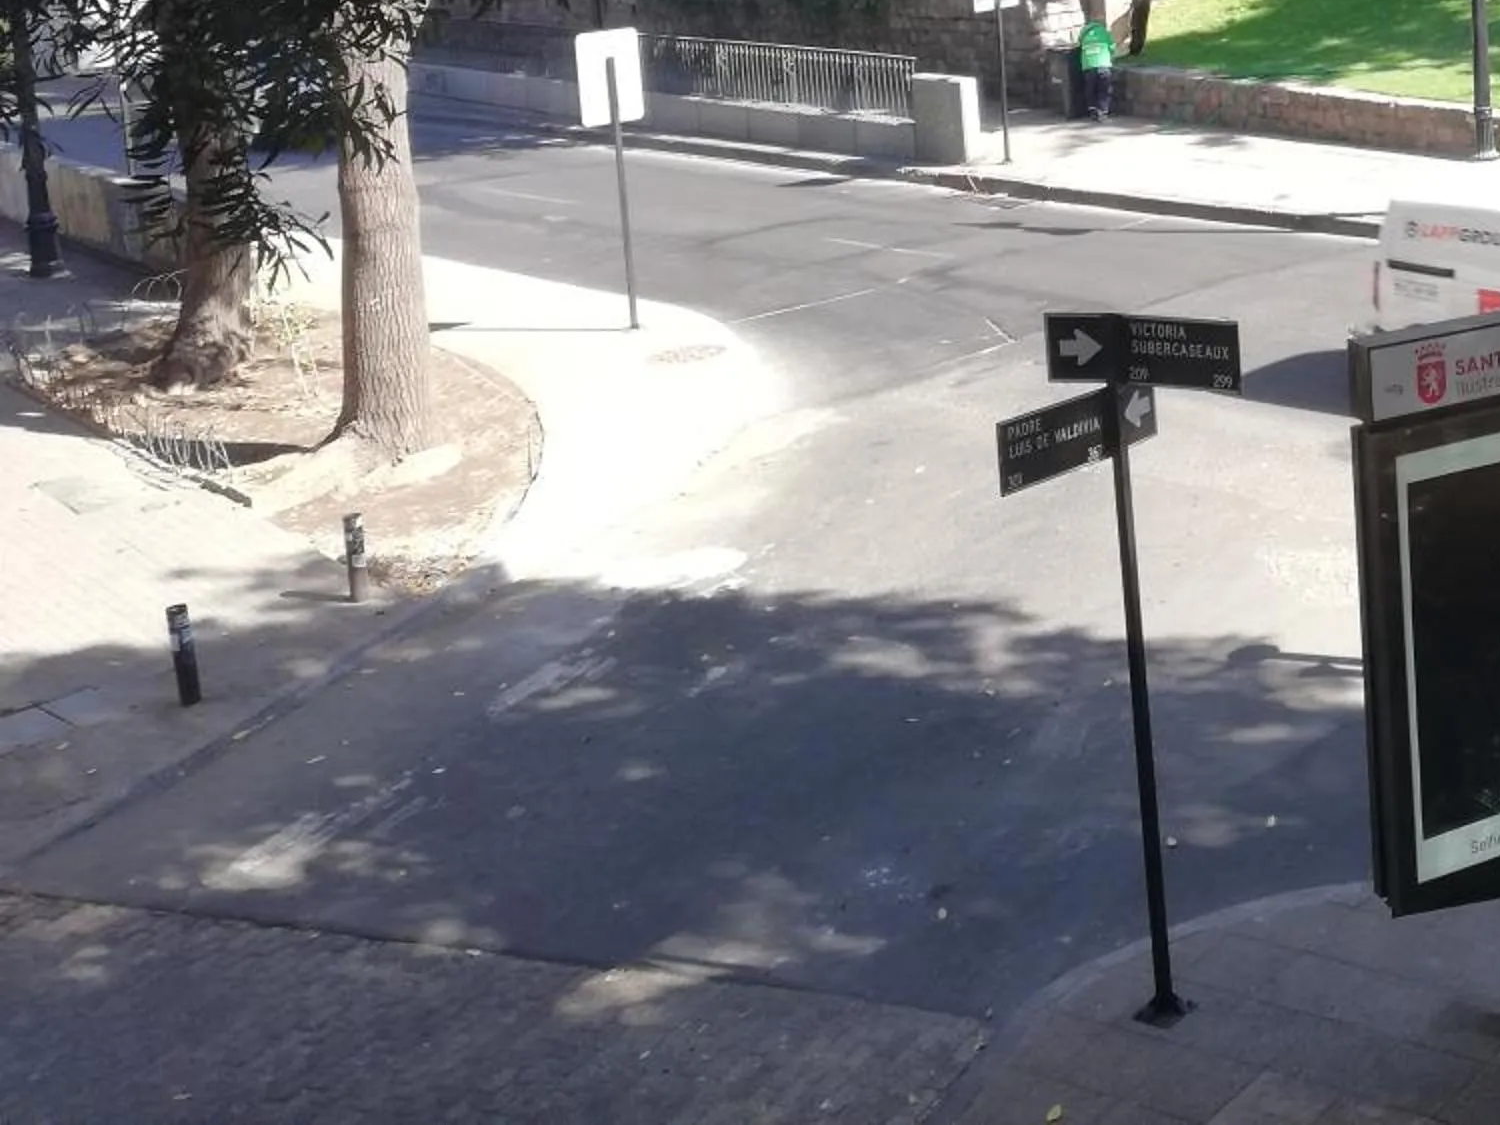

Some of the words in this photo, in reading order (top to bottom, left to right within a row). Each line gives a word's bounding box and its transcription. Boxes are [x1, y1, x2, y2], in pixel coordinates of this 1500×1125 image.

[1129, 322, 1187, 340] VICTORIA
[1131, 339, 1229, 360] SUBERCASEAUX
[1054, 416, 1101, 444] VALDIVIA
